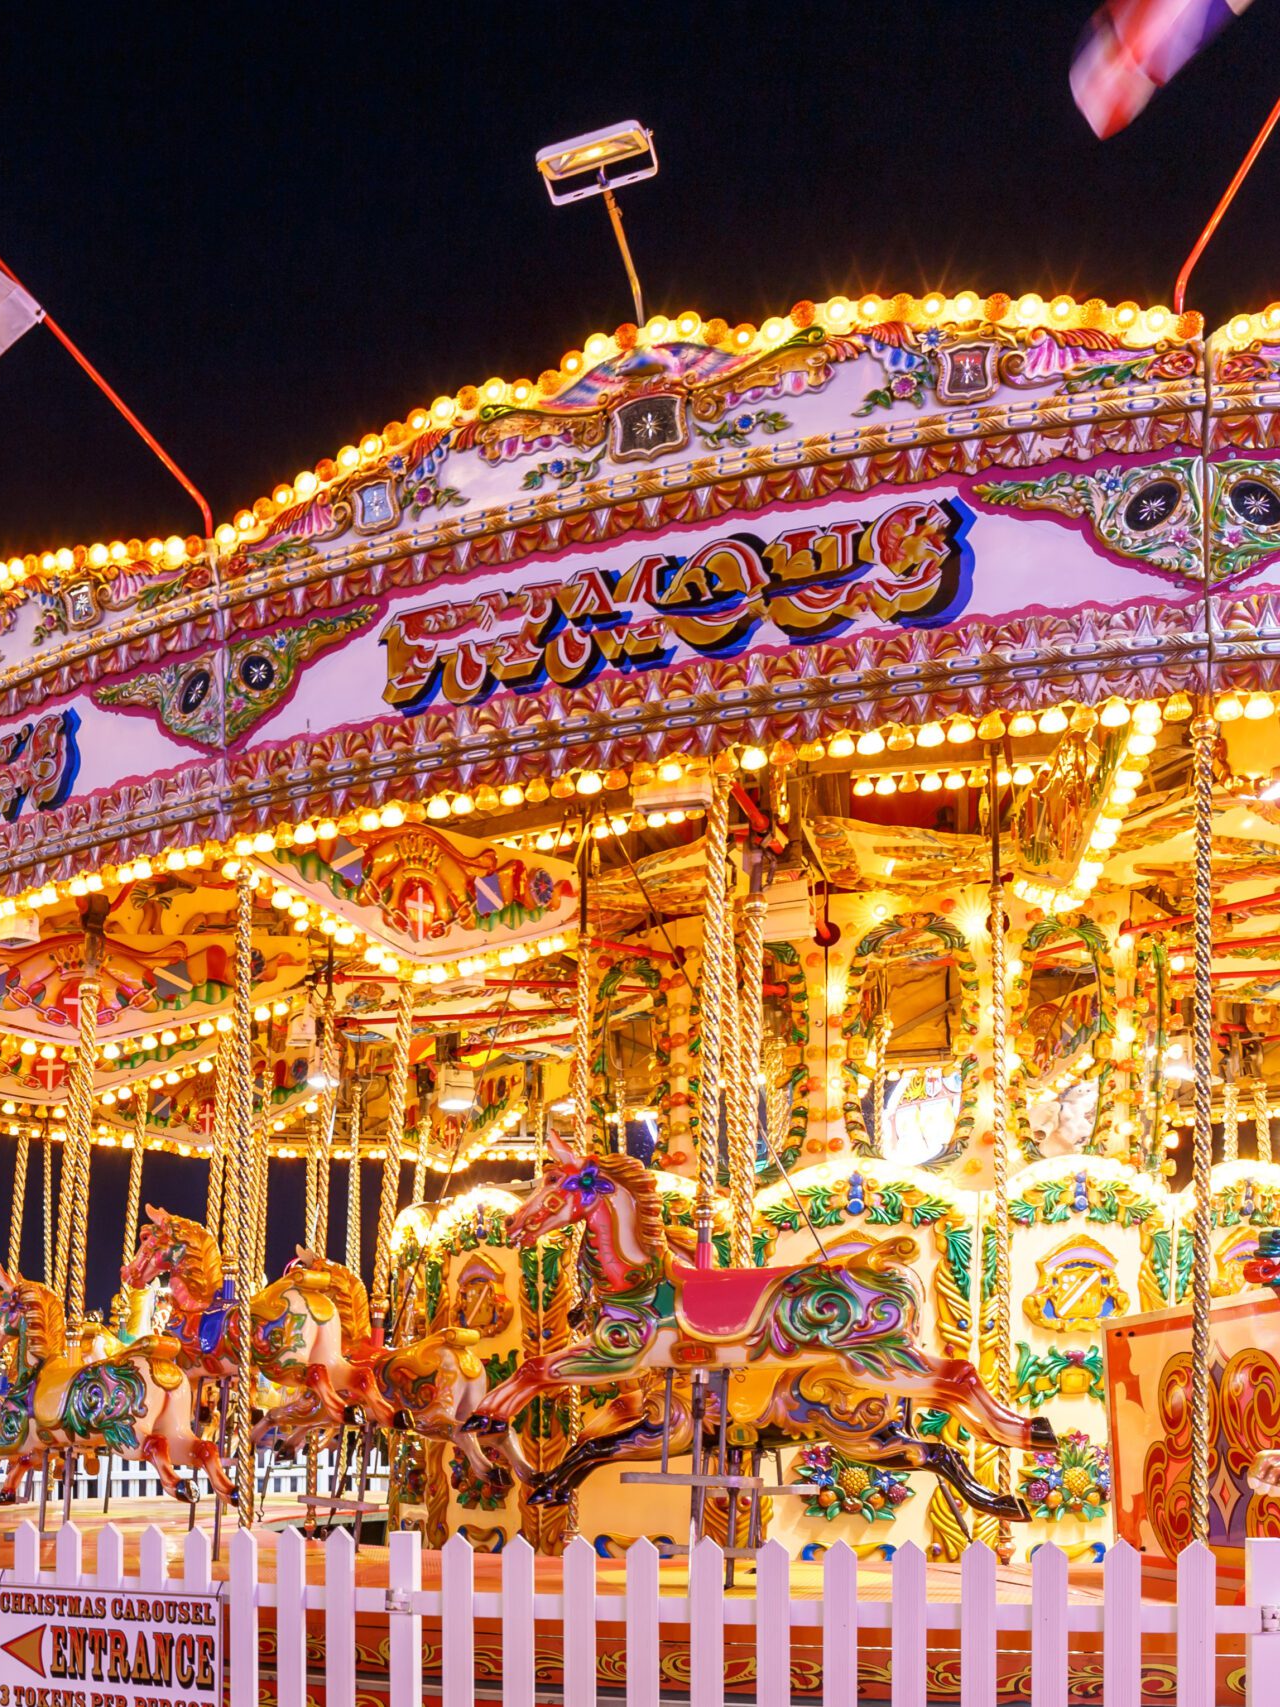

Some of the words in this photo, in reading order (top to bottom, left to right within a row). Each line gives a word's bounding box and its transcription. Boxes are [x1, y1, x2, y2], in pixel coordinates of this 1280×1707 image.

[0, 1592, 106, 1619] CHRISTMAS
[111, 1596, 216, 1625] CAROUSEL
[49, 1624, 216, 1691] ENTRANCE
[0, 1684, 10, 1706] 3
[14, 1685, 87, 1707] TOKENS
